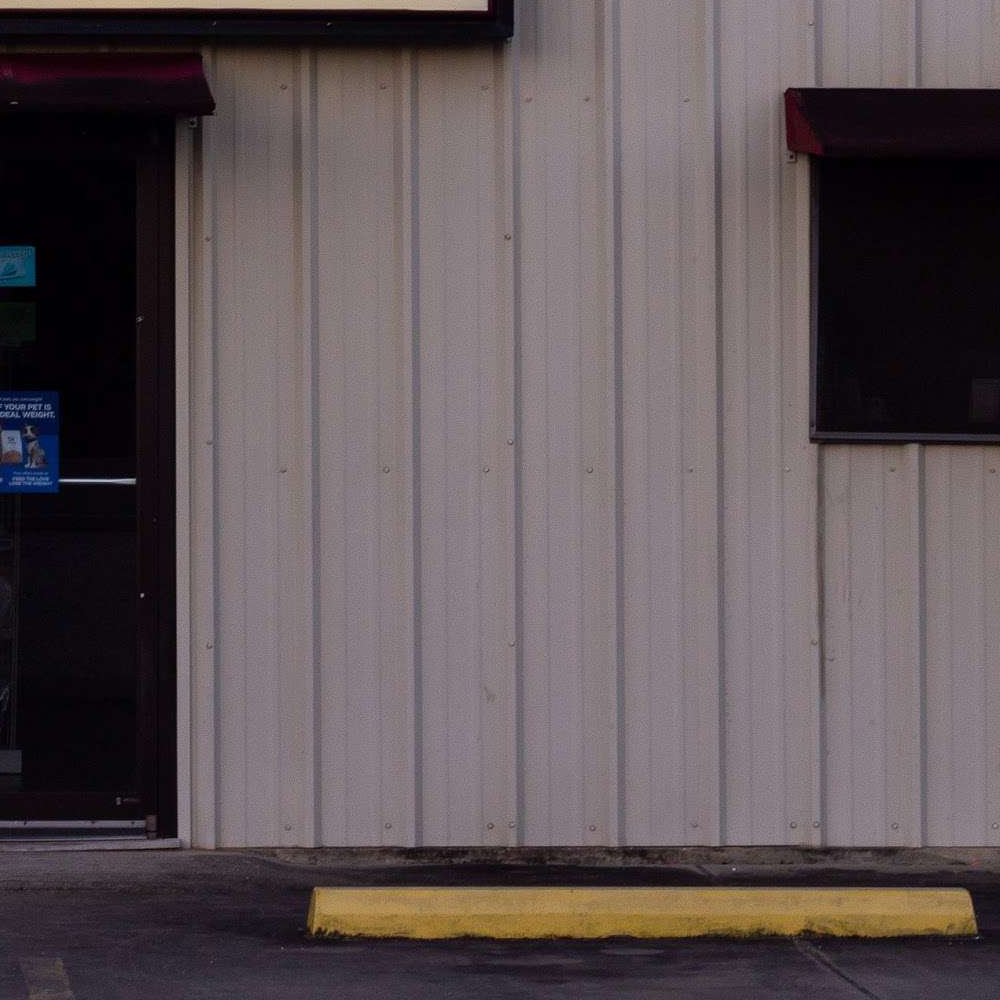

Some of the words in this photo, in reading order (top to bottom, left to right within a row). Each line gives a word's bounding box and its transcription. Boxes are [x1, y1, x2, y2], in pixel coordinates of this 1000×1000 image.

[4, 403, 26, 411] YOUR
[27, 403, 42, 411] PET
[43, 403, 52, 411] IS
